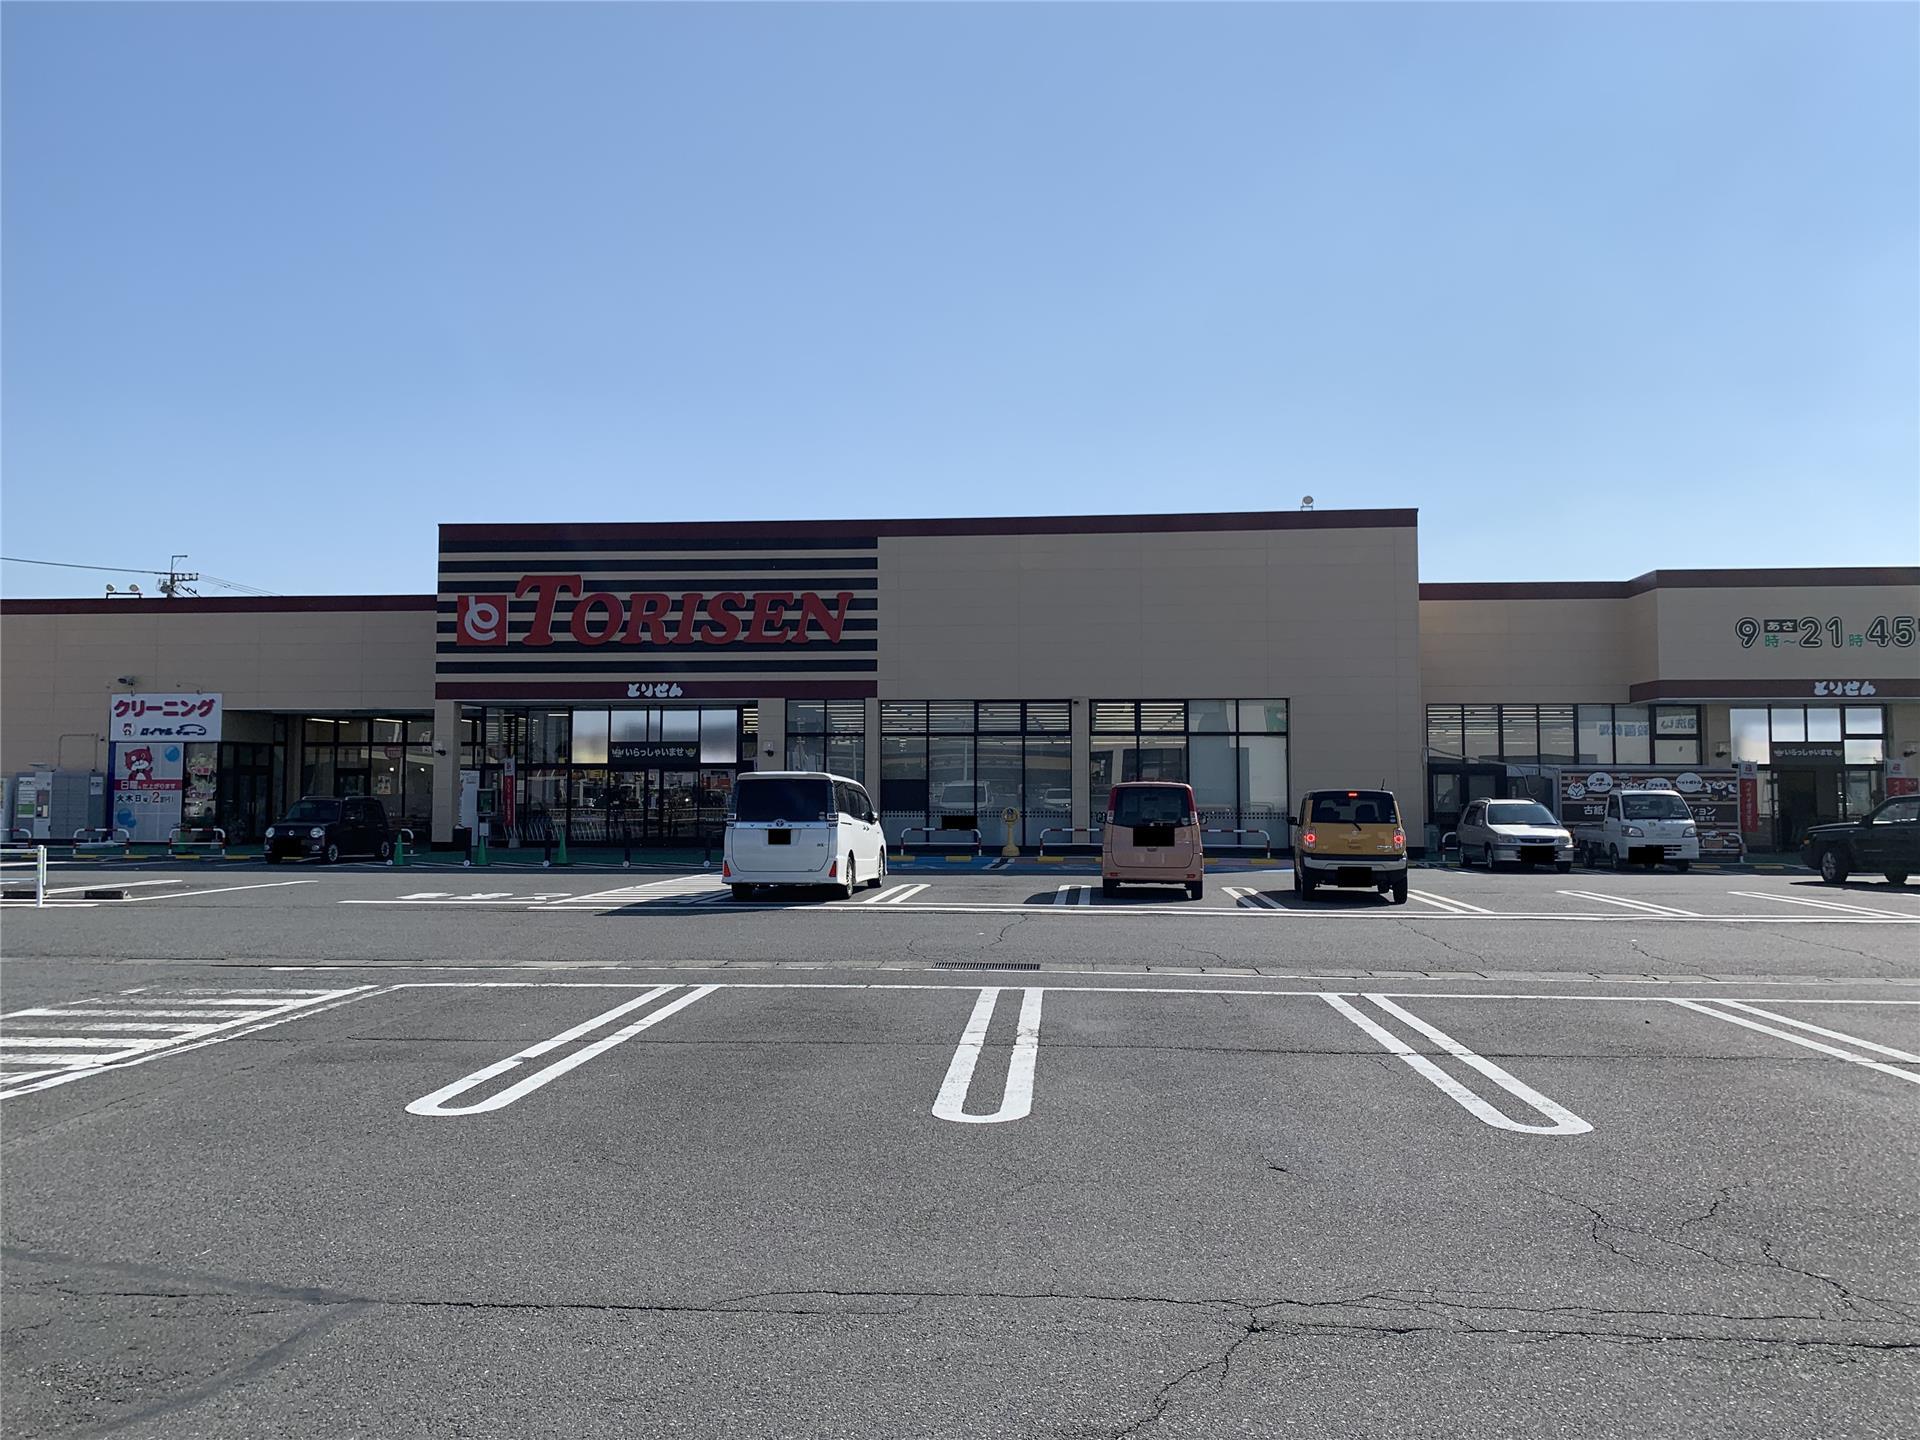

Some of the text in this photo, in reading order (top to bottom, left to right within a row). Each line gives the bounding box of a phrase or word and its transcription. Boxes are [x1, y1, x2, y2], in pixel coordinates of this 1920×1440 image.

[515, 574, 854, 646] TORISEN
[1767, 621, 1795, 632] あさ
[626, 682, 684, 698] とりせん
[1813, 680, 1876, 696] とりせん
[114, 699, 216, 718] クリーニング
[625, 747, 685, 758] いらっしゃいませ
[1784, 748, 1833, 757] いらっしゃいませ
